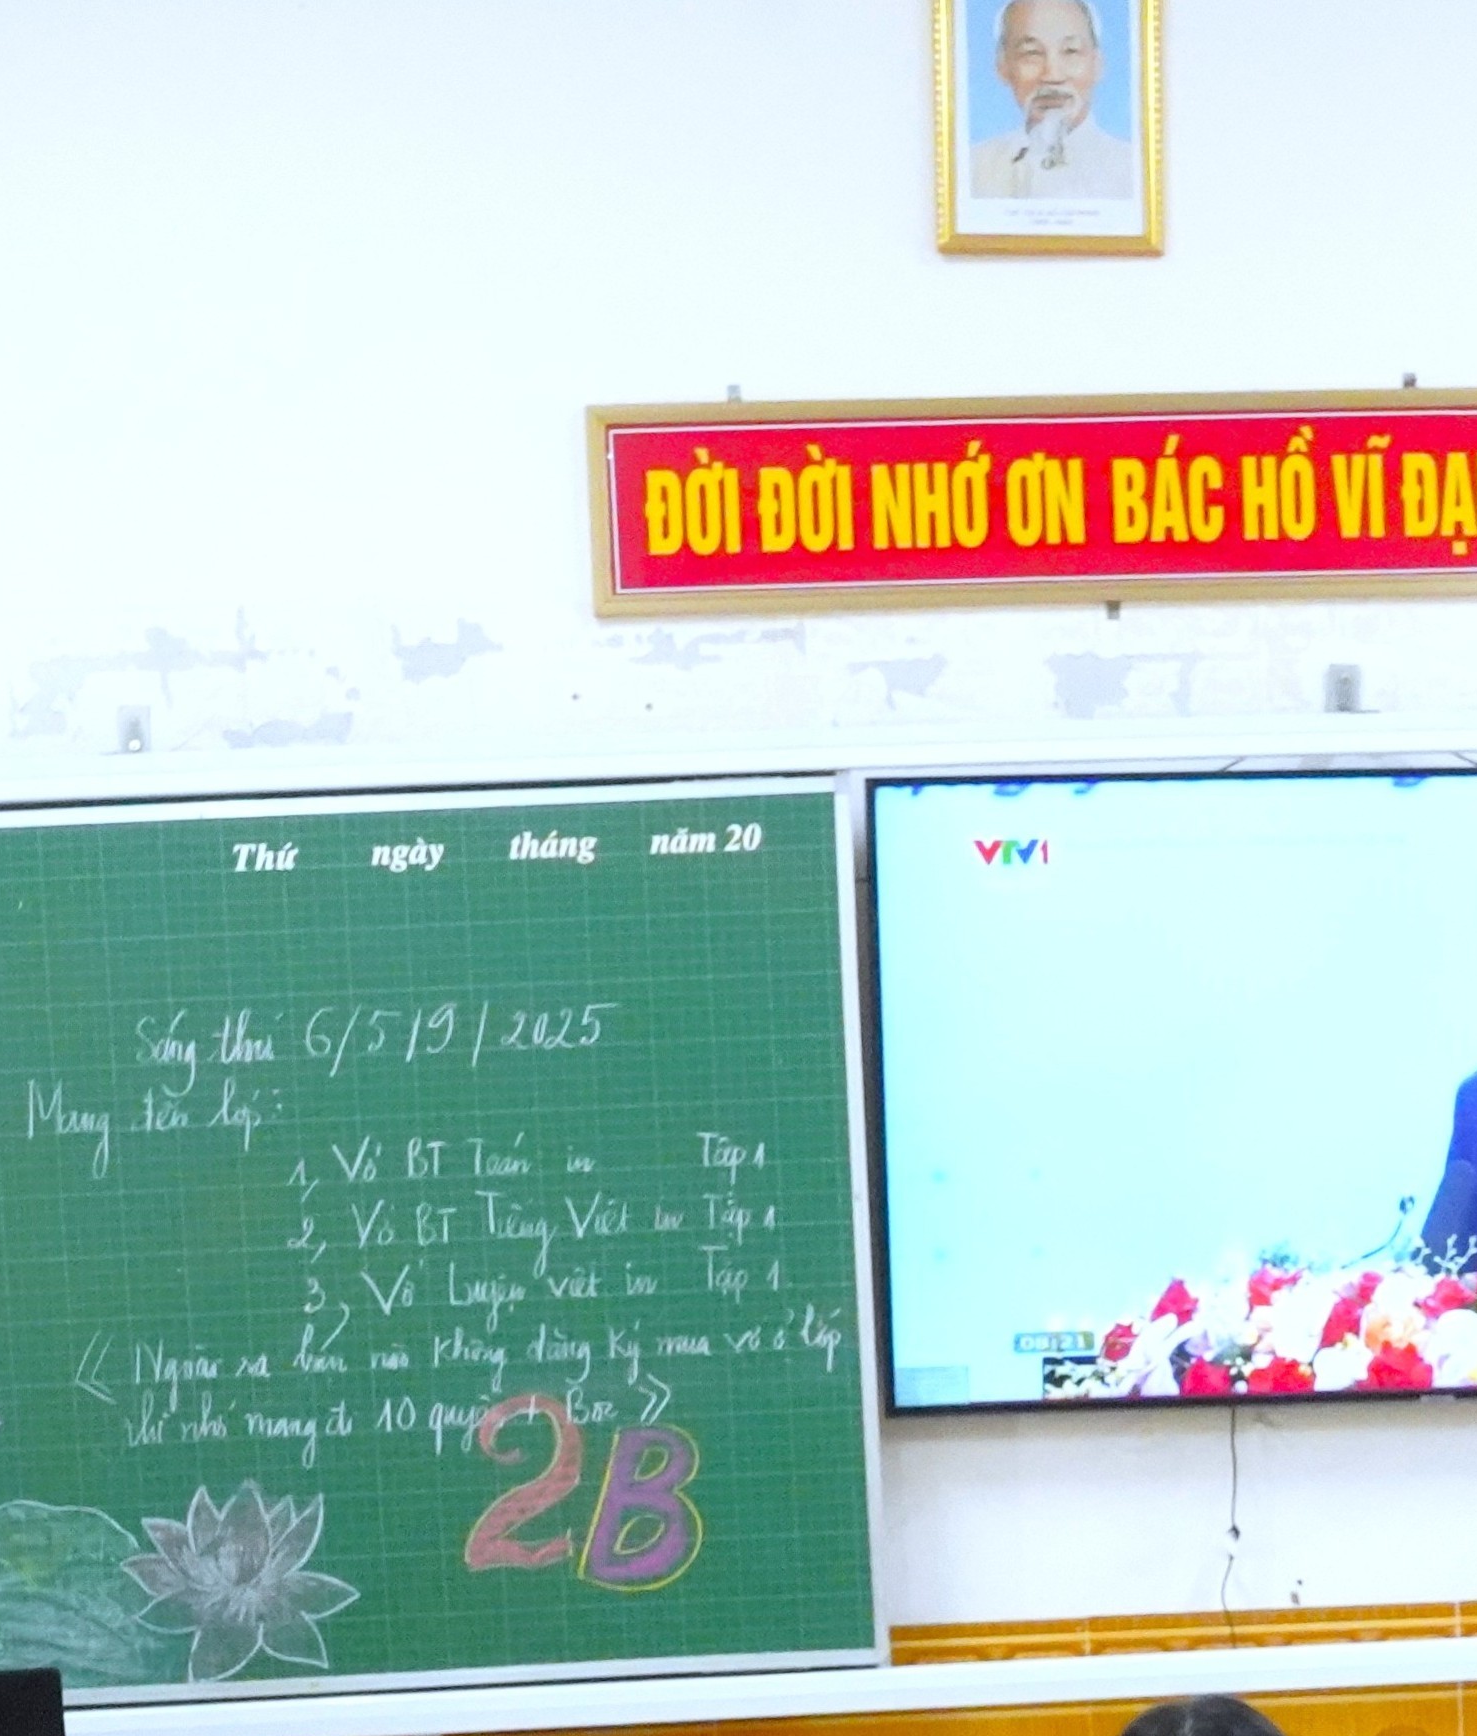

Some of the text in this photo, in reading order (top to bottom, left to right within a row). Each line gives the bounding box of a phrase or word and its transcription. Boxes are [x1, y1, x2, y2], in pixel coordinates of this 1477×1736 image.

[644, 446, 742, 556] ĐỜI
[757, 442, 855, 554] ĐỜI
[871, 439, 992, 550] NHỚ
[1005, 451, 1087, 548] ƠN
[1111, 433, 1225, 544] BÁC
[1241, 425, 1316, 541] HỒ
[1330, 433, 1392, 539] VĨ
[231, 822, 763, 874] Thứ ngày tháng năm 20
[973, 838, 1048, 865] VTV1
[27, 1077, 111, 1179] Mang
[407, 1136, 447, 1178] BT
[415, 1202, 457, 1247] BT
[378, 1397, 416, 1432] 10
[464, 1391, 705, 1593] 2B
